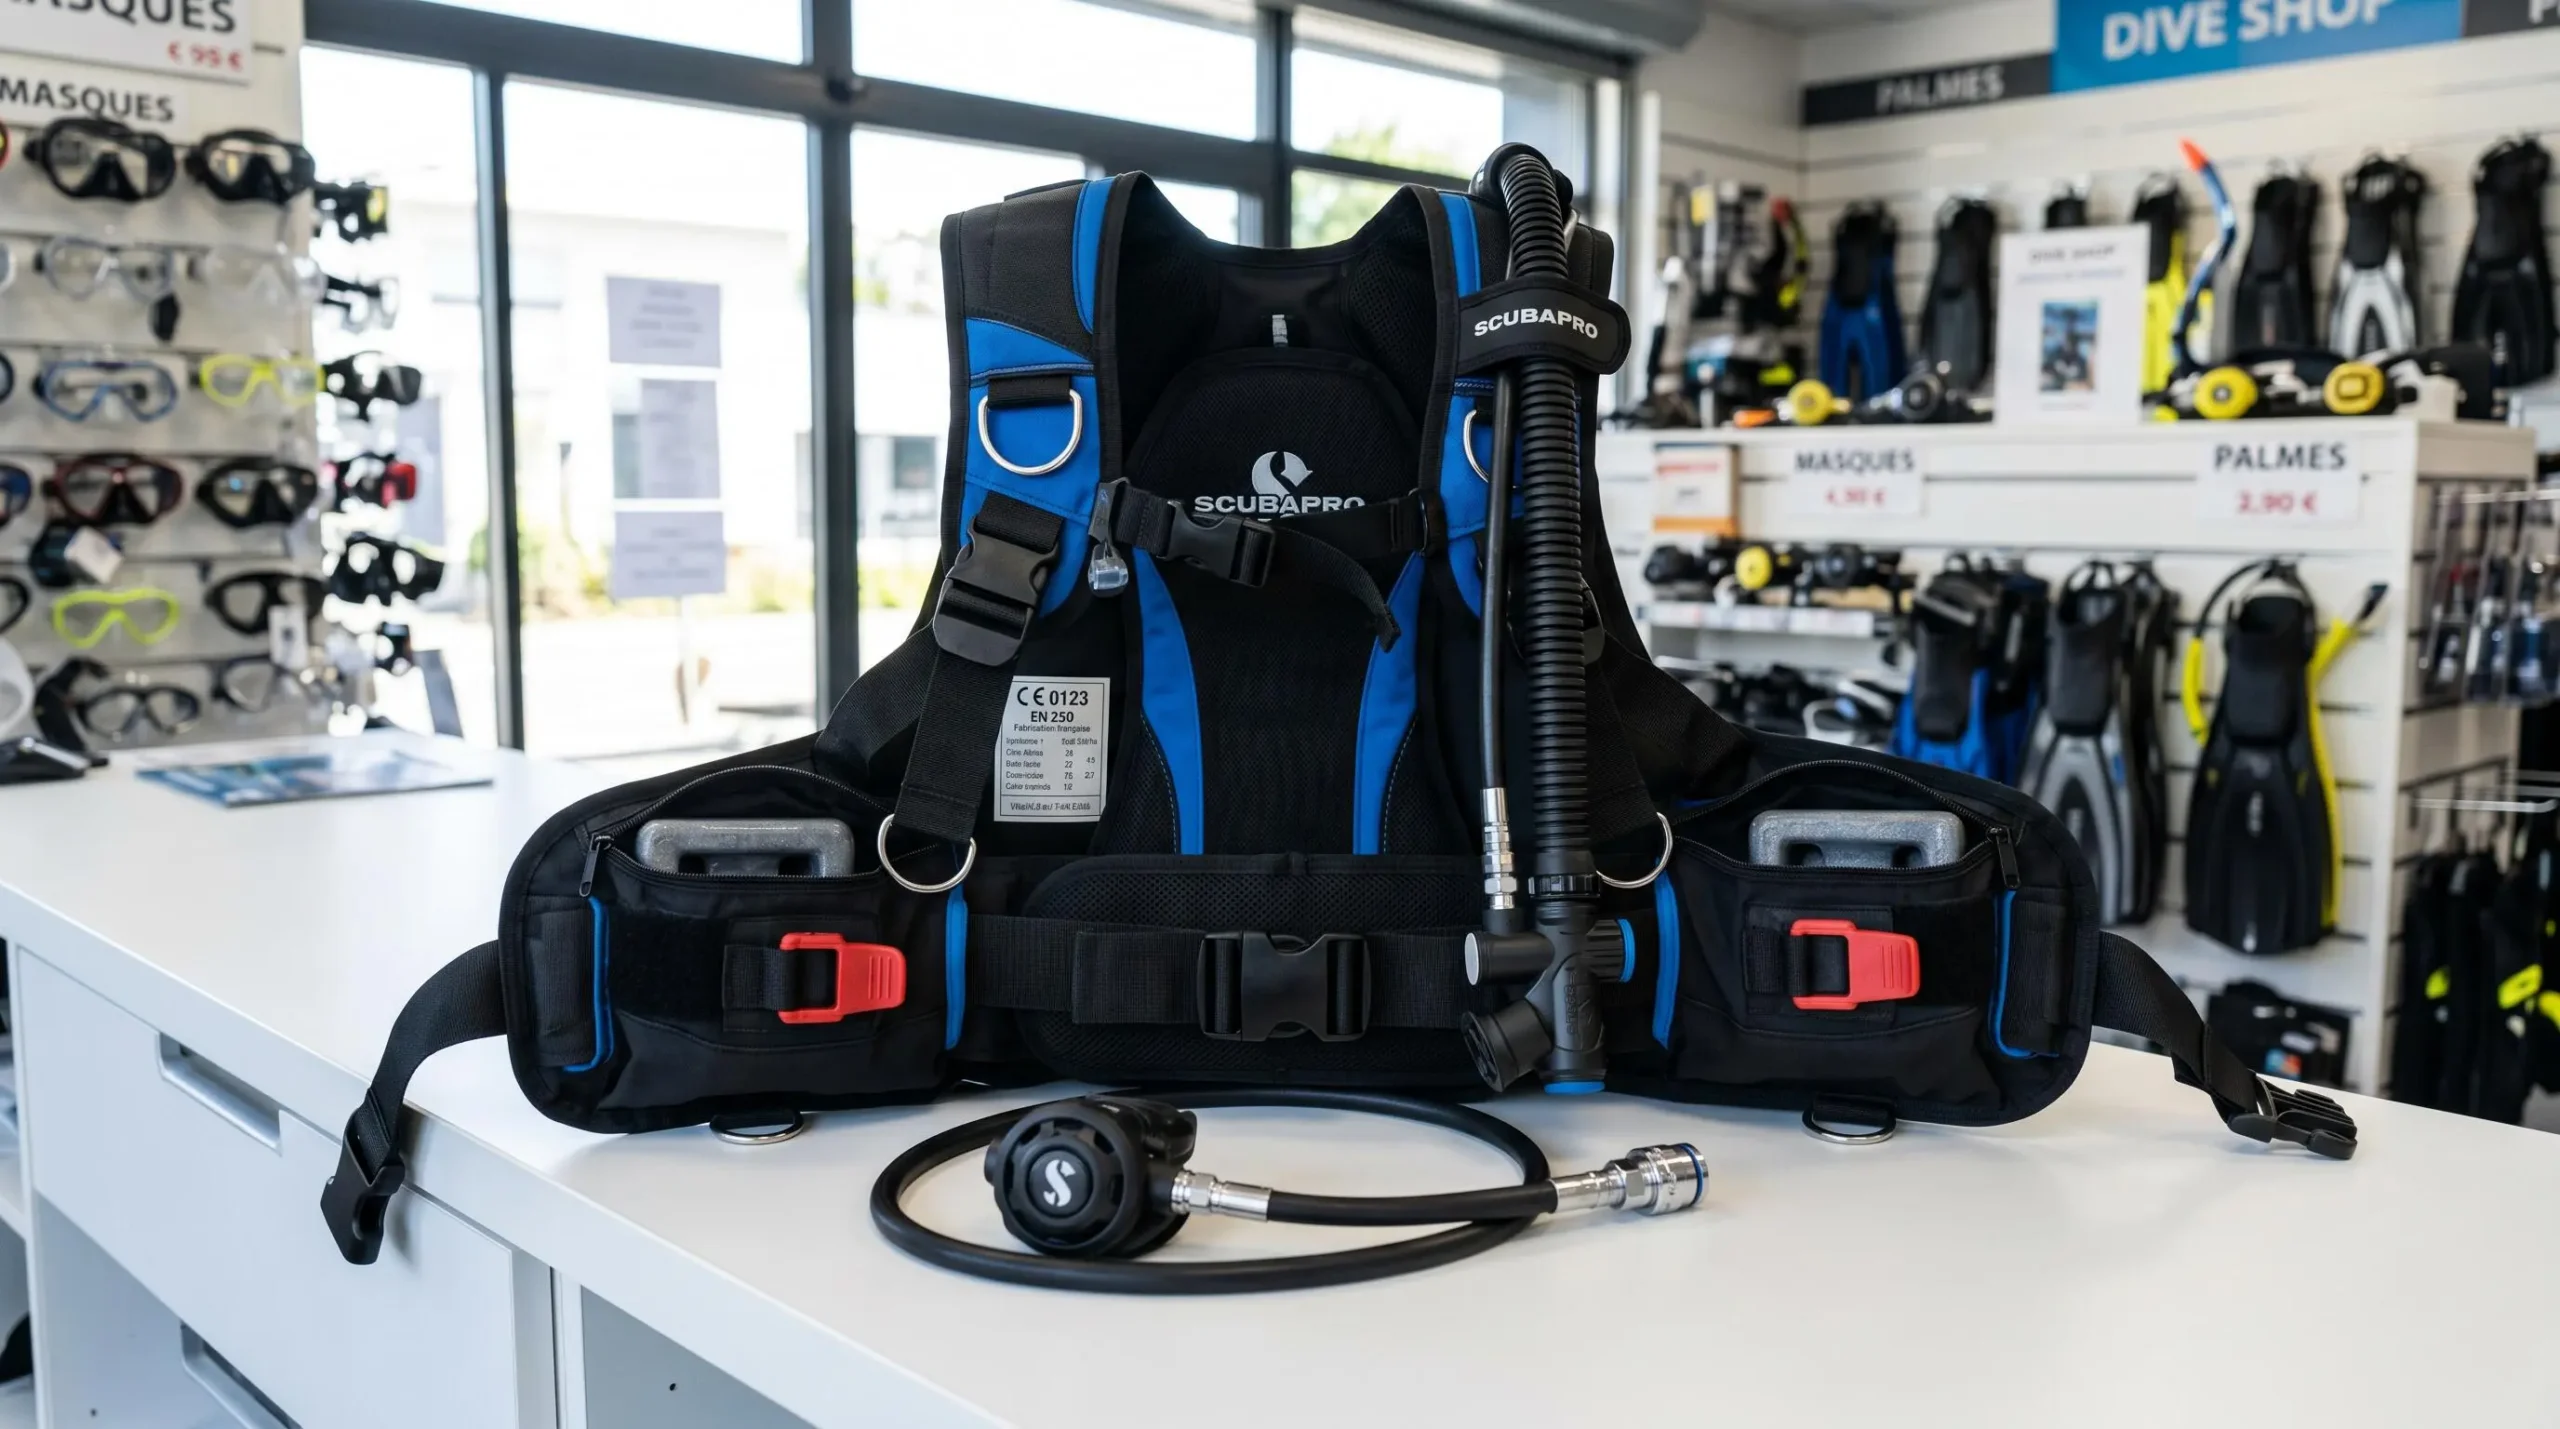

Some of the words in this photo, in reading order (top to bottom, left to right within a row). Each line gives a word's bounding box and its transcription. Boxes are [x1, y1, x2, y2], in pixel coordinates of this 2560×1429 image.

[12, 0, 236, 33] QUES
[2102, 2, 2227, 61] DIVE
[0, 78, 174, 122] MASQUES
[1875, 65, 2004, 114] PALMES
[1474, 308, 1598, 339] SCUBAPRO
[1795, 449, 1915, 474] MASQUES
[2215, 442, 2347, 472] PALMES
[1049, 690, 1088, 706] 0123
[1031, 711, 1048, 722] EN
[1051, 711, 1074, 722] 250
